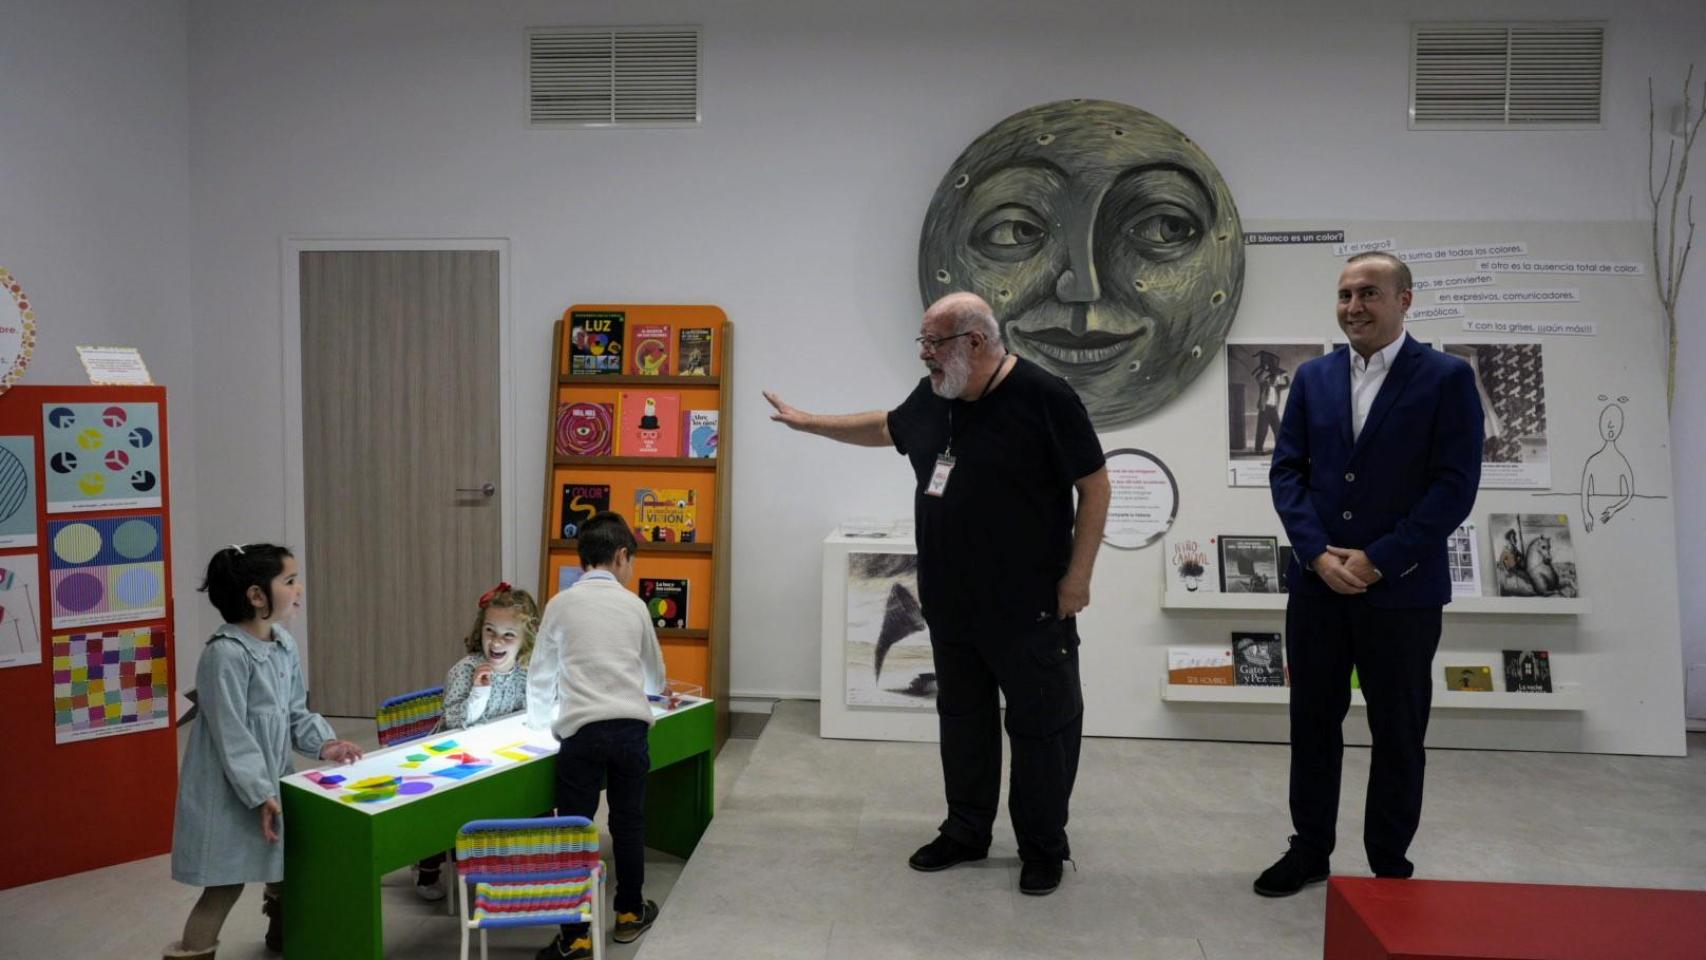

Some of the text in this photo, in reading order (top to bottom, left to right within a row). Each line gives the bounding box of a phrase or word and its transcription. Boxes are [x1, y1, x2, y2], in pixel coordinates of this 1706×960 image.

[1258, 233, 1289, 242] blanco
[1291, 234, 1301, 242] es
[1303, 233, 1314, 242] un
[1316, 232, 1344, 242] color?
[1338, 240, 1392, 254] ¿Y el negro?
[1409, 251, 1433, 260] suma
[1434, 249, 1446, 258] de
[1448, 247, 1473, 257] todos
[1475, 247, 1487, 256] los
[1489, 245, 1524, 255] colores.
[1491, 262, 1509, 270] otro
[1511, 263, 1521, 271] es
[1523, 262, 1532, 271] la
[1534, 263, 1574, 272] ausencia
[1576, 263, 1597, 272] total
[1599, 264, 1611, 272] de
[1614, 264, 1639, 273] color.
[1433, 279, 1443, 287] se
[1445, 274, 1492, 286] convierten
[1502, 291, 1575, 301] comunicadores.
[585, 319, 612, 332] LUZ
[1475, 322, 1493, 330] con
[1495, 322, 1507, 331] los
[1565, 324, 1592, 333] más!!!
[1229, 468, 1237, 486] 1
[572, 487, 603, 499] COLOR
[1239, 664, 1264, 674] Gato
[1251, 674, 1267, 682] Pez
